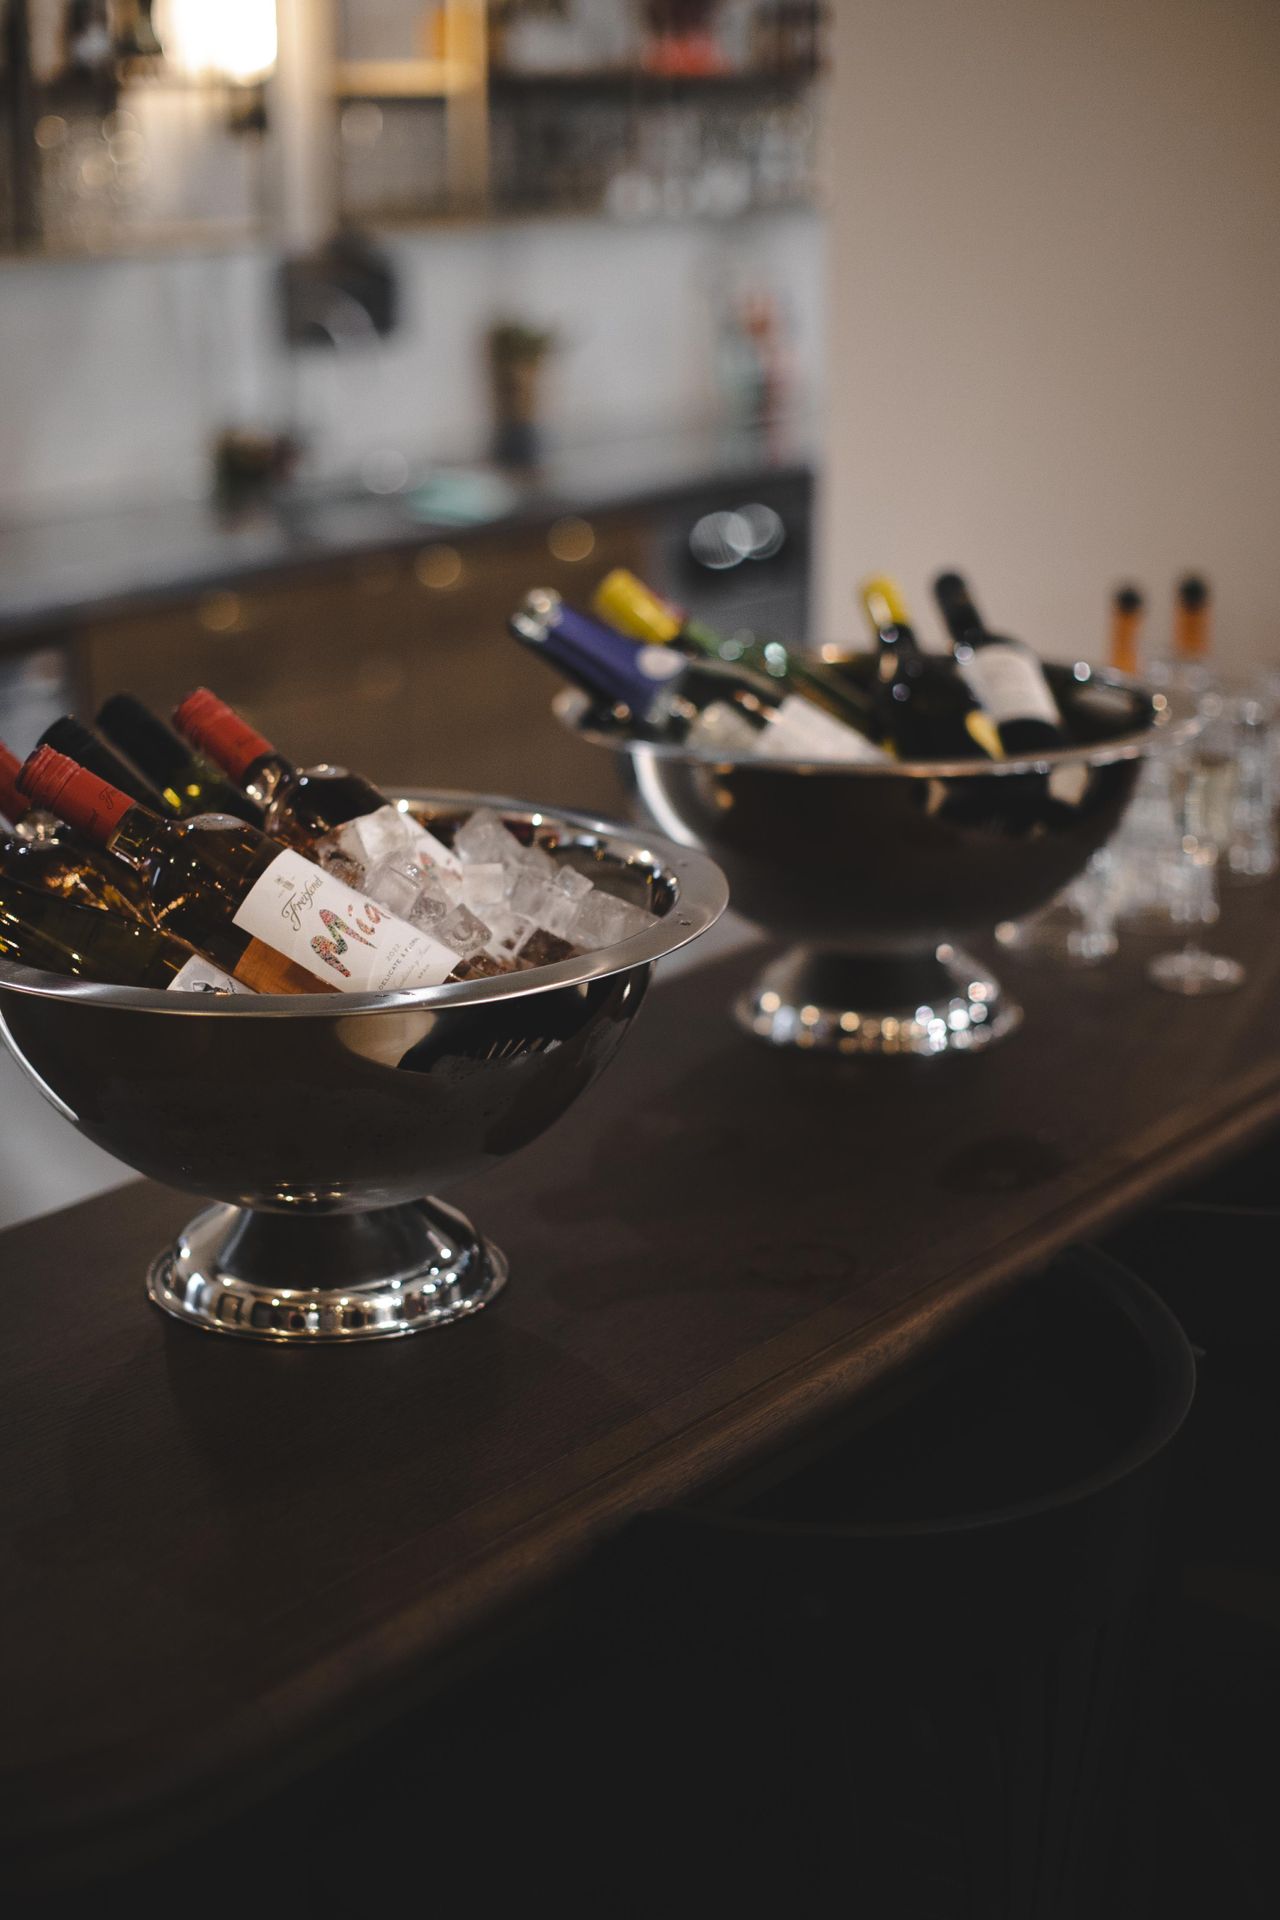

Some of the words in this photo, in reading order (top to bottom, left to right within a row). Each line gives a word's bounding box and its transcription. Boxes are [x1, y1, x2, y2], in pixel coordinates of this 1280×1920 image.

[311, 903, 391, 977] Mia
[386, 943, 402, 962] 2022
[379, 958, 402, 991] DELICATE
